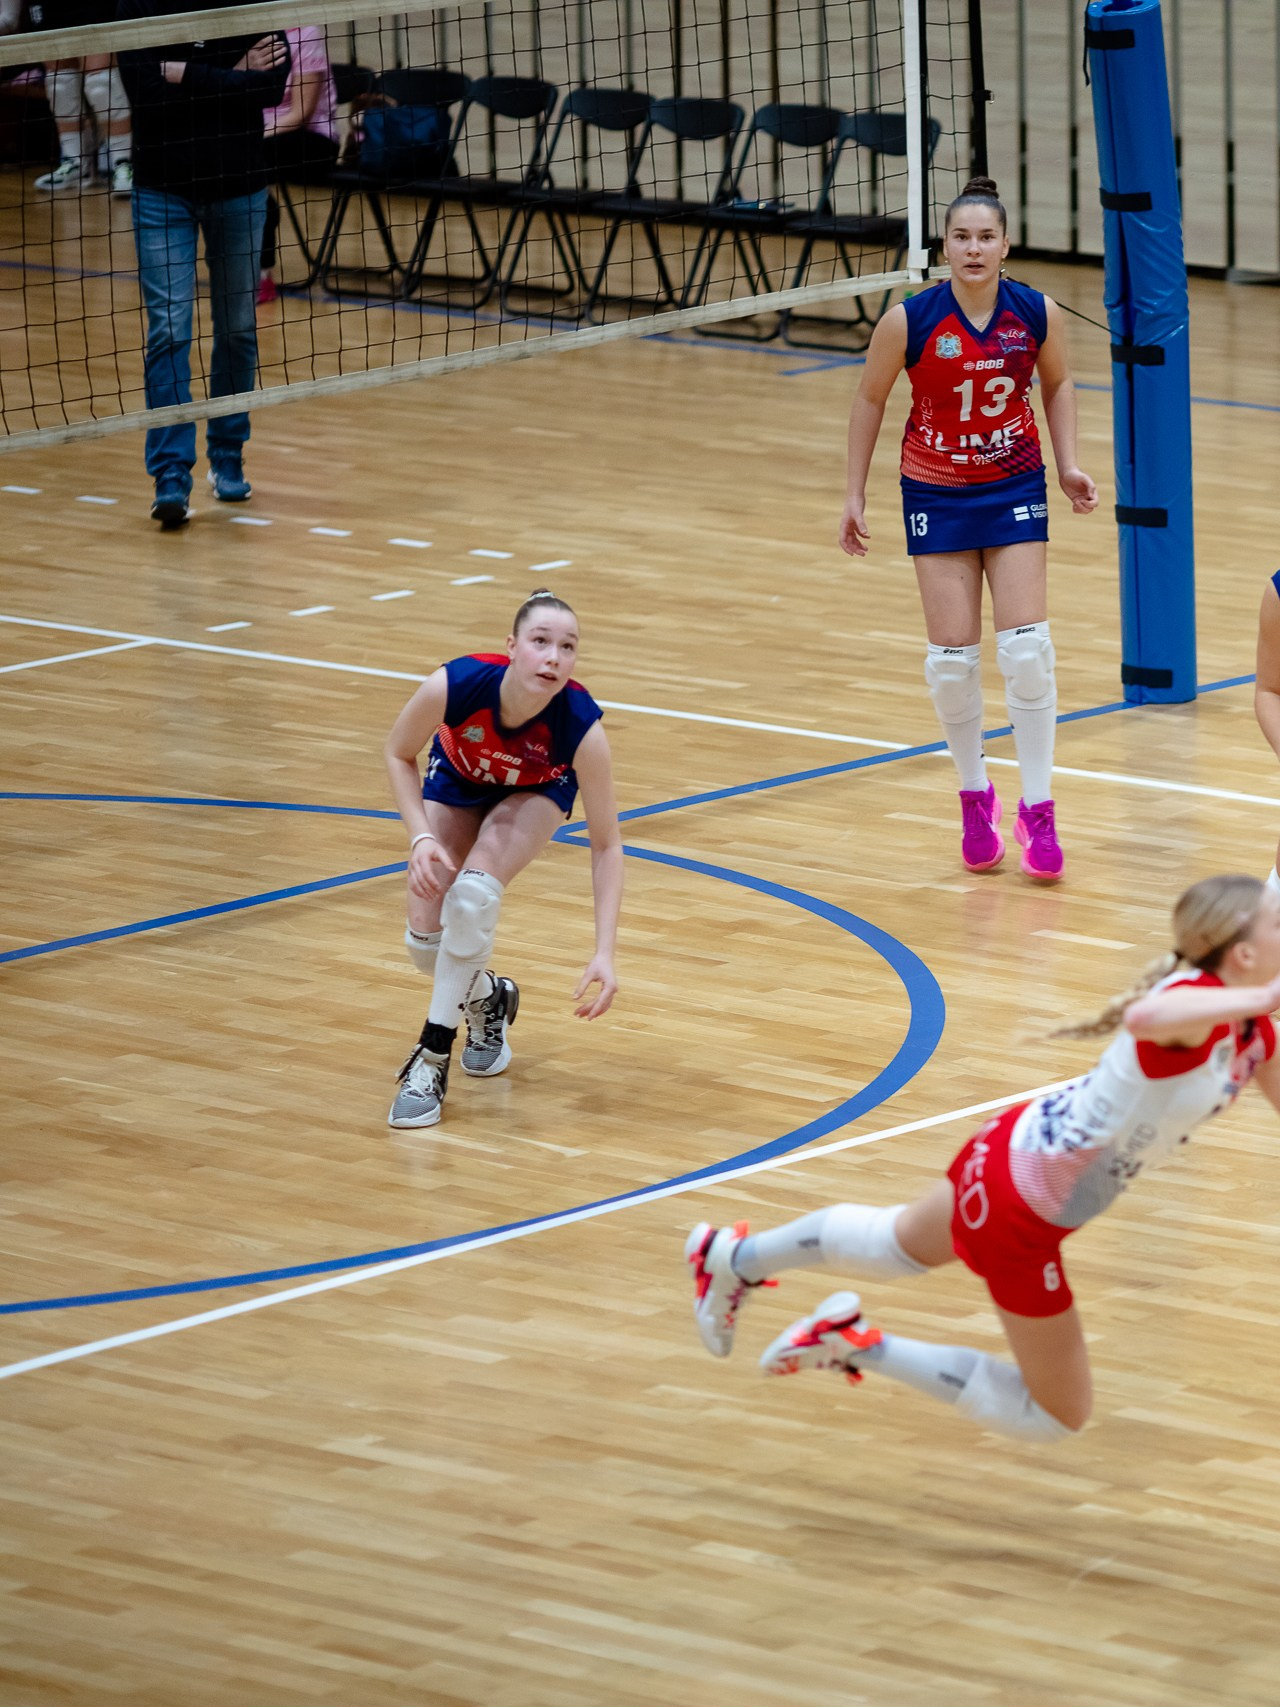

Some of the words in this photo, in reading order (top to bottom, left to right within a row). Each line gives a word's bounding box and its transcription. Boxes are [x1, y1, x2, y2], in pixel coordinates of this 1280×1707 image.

[975, 359, 1004, 370] ВФВ
[953, 376, 1016, 422] 13
[935, 420, 1024, 451] LIME
[910, 513, 928, 536] 13
[492, 751, 522, 766] ВФВ
[1043, 1261, 1060, 1291] 6
